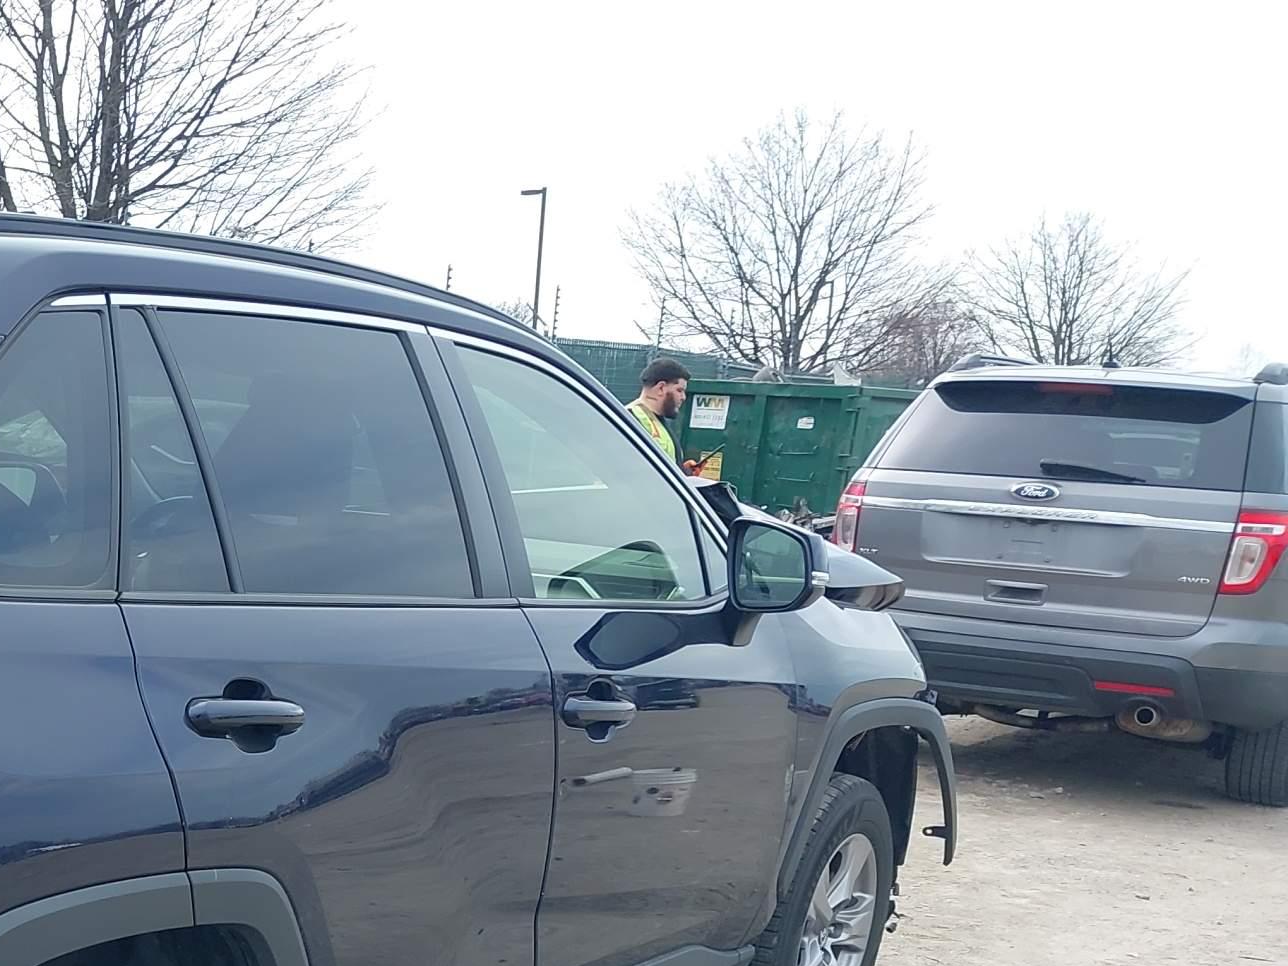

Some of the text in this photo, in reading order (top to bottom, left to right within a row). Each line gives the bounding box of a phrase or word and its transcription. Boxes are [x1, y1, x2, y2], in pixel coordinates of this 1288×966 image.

[696, 397, 725, 408] WM
[1020, 485, 1049, 497] Ford
[1176, 576, 1211, 584] 4WD
